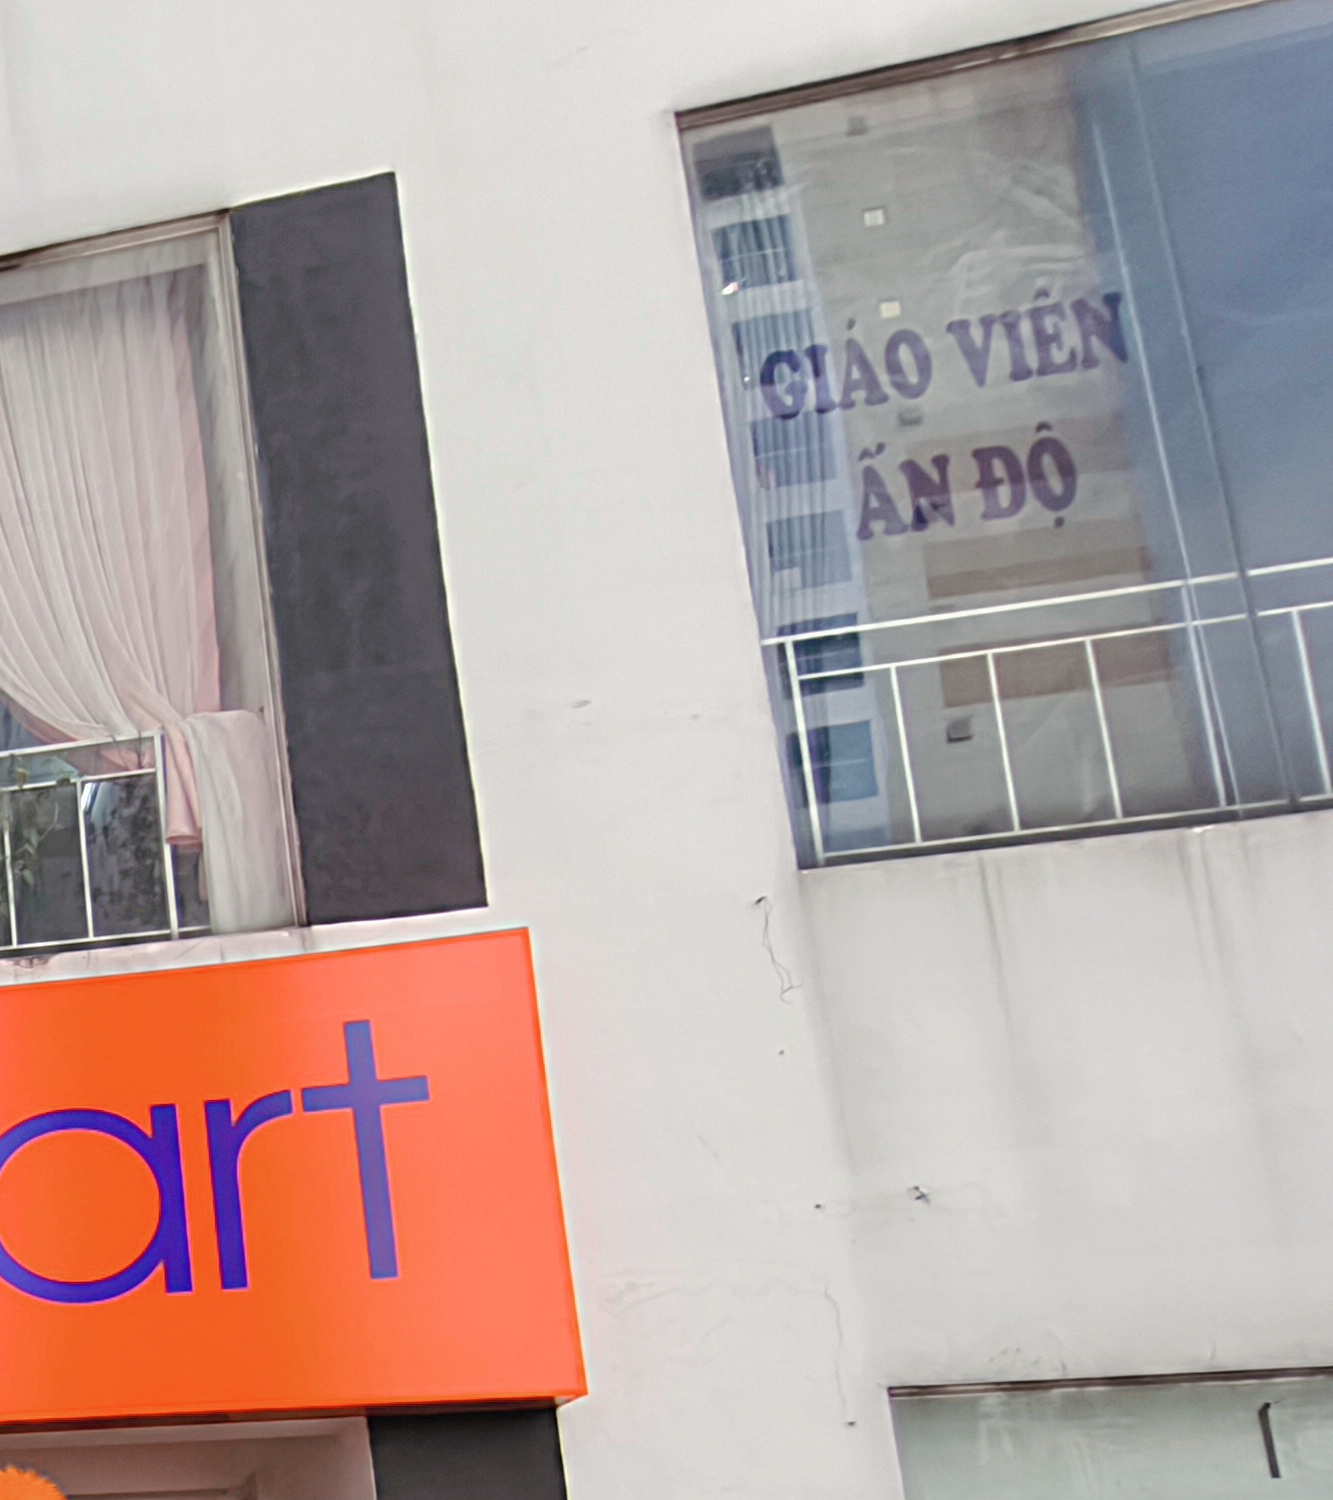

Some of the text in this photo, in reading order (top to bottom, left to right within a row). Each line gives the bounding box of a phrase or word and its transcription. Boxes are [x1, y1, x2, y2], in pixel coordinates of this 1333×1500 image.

[760, 288, 1127, 420] GIÁO VIÊN
[857, 422, 1077, 540] ẤN ĐỘ
